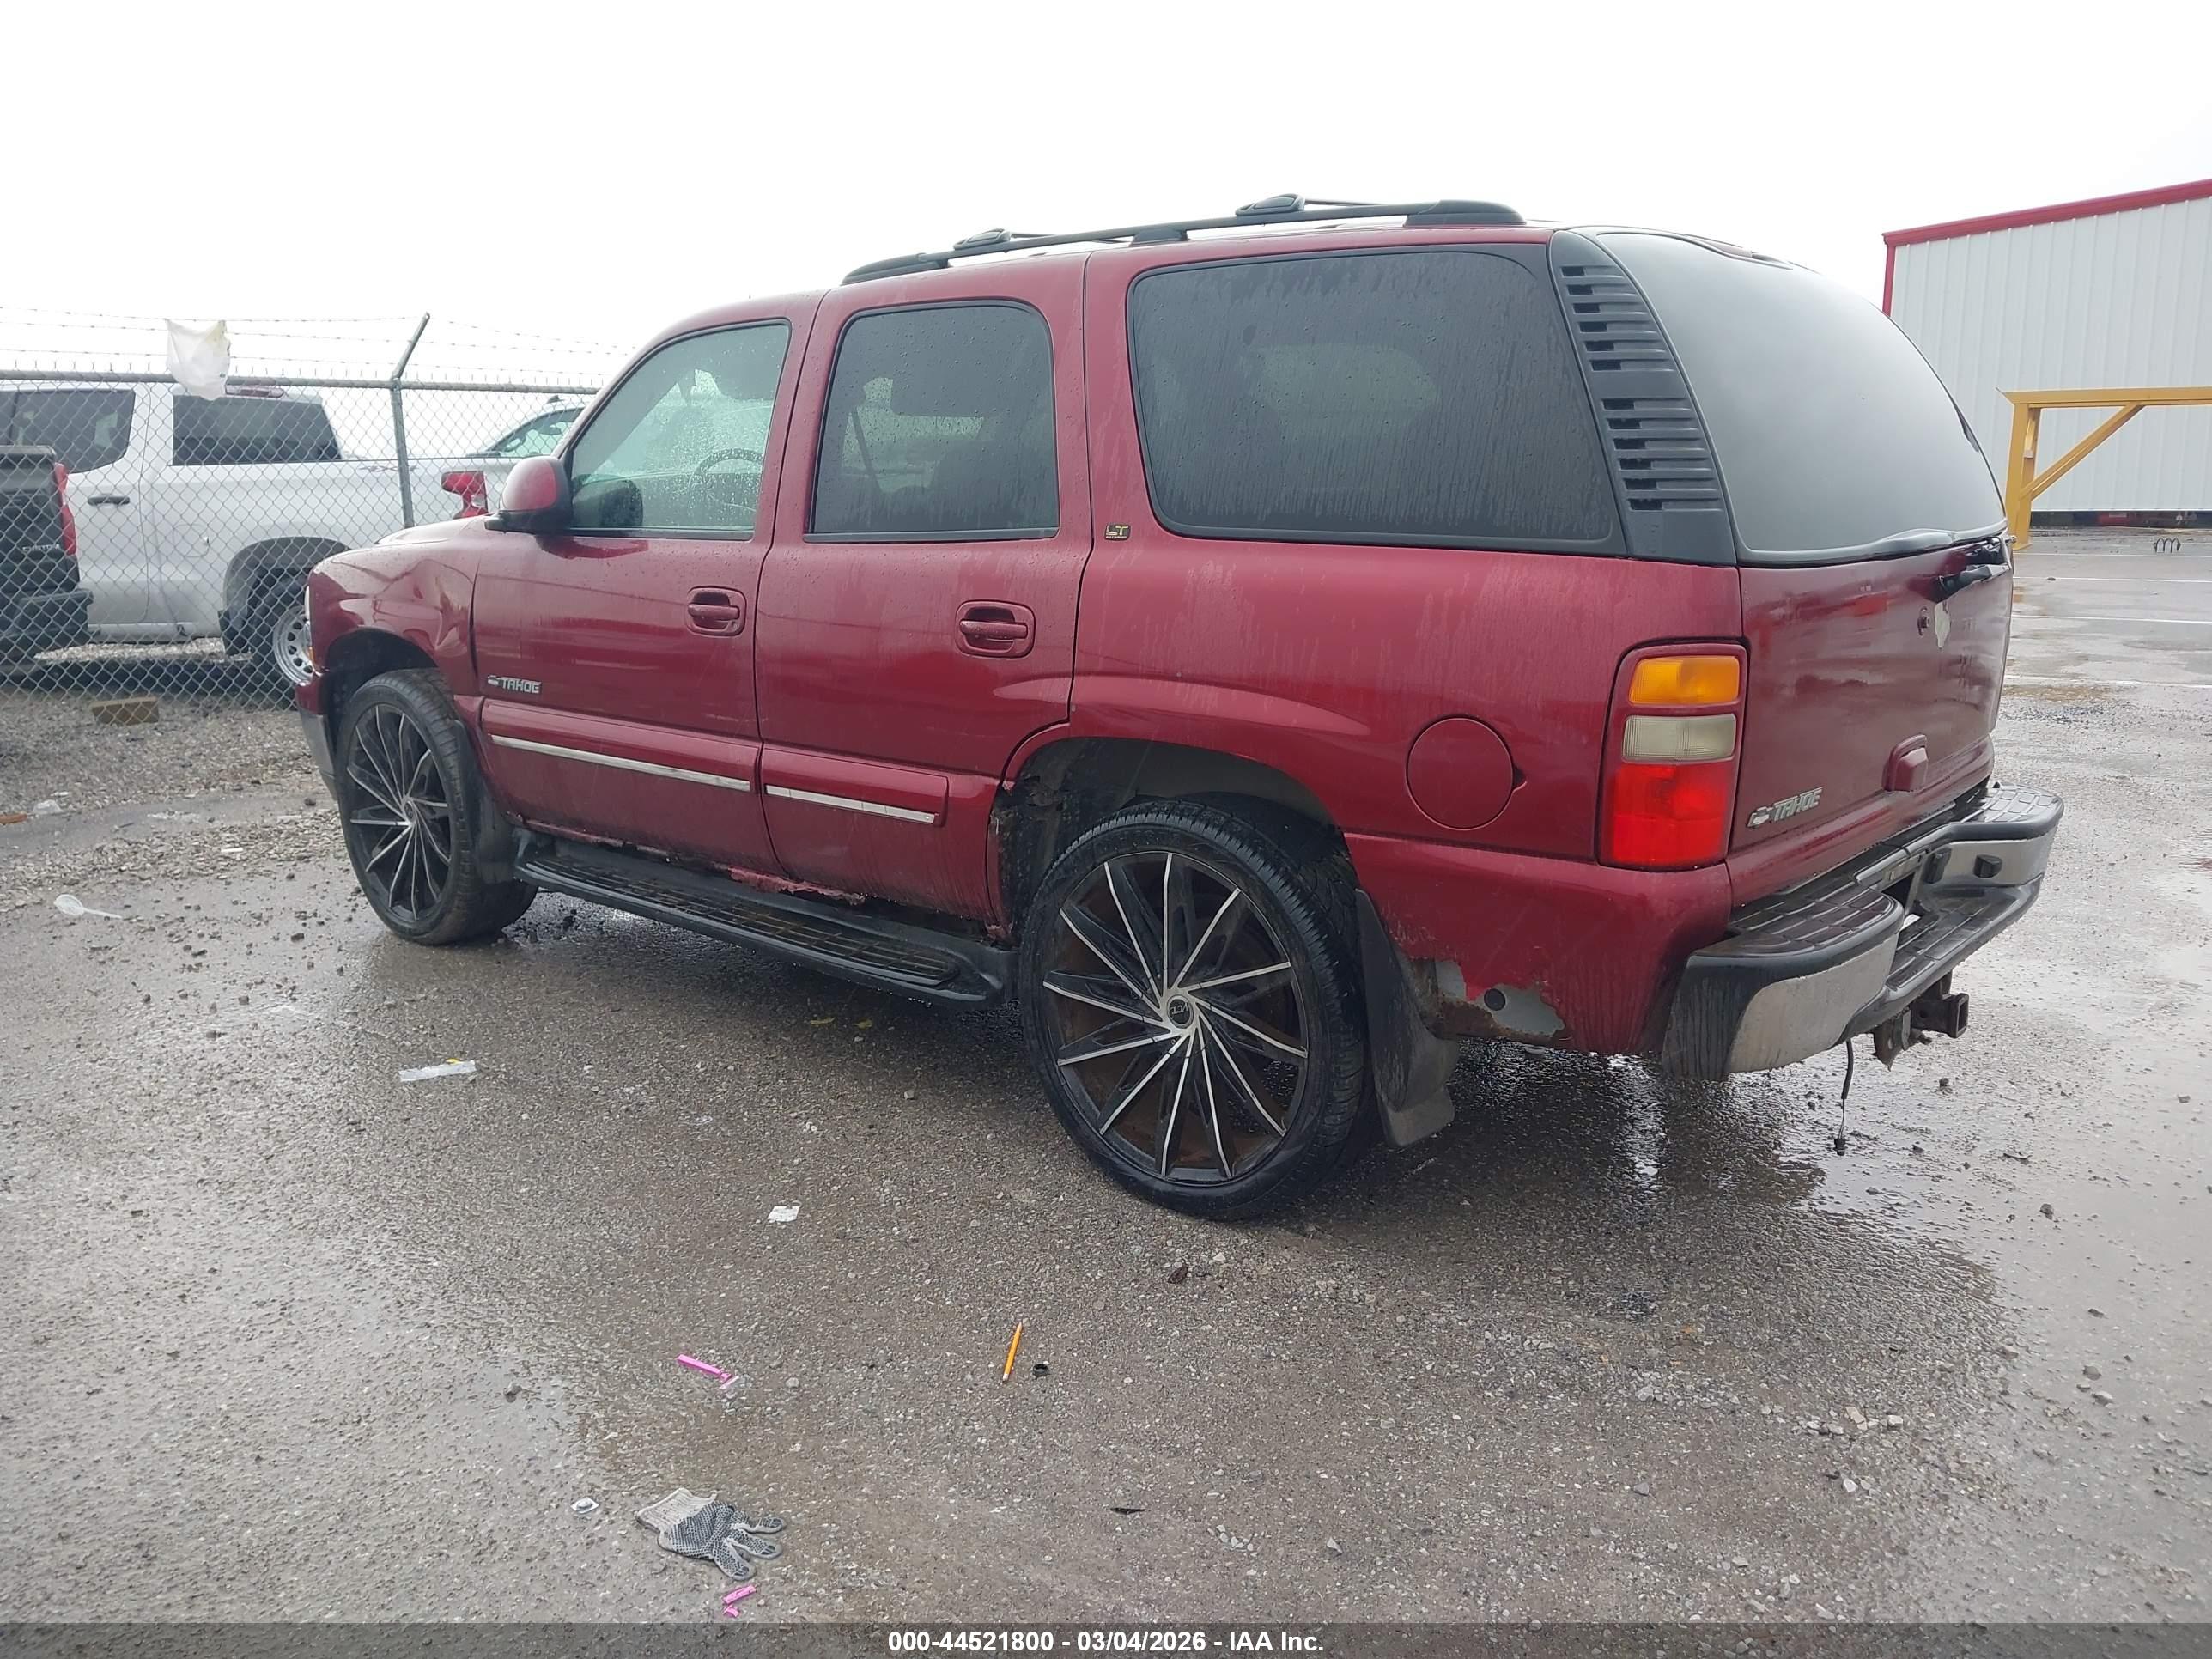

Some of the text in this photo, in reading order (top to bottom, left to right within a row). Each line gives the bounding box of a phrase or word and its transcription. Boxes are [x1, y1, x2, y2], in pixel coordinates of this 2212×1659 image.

[1106, 525, 1128, 536] LT
[501, 676, 542, 694] TAHOE
[1773, 786, 1823, 822] TAHOE
